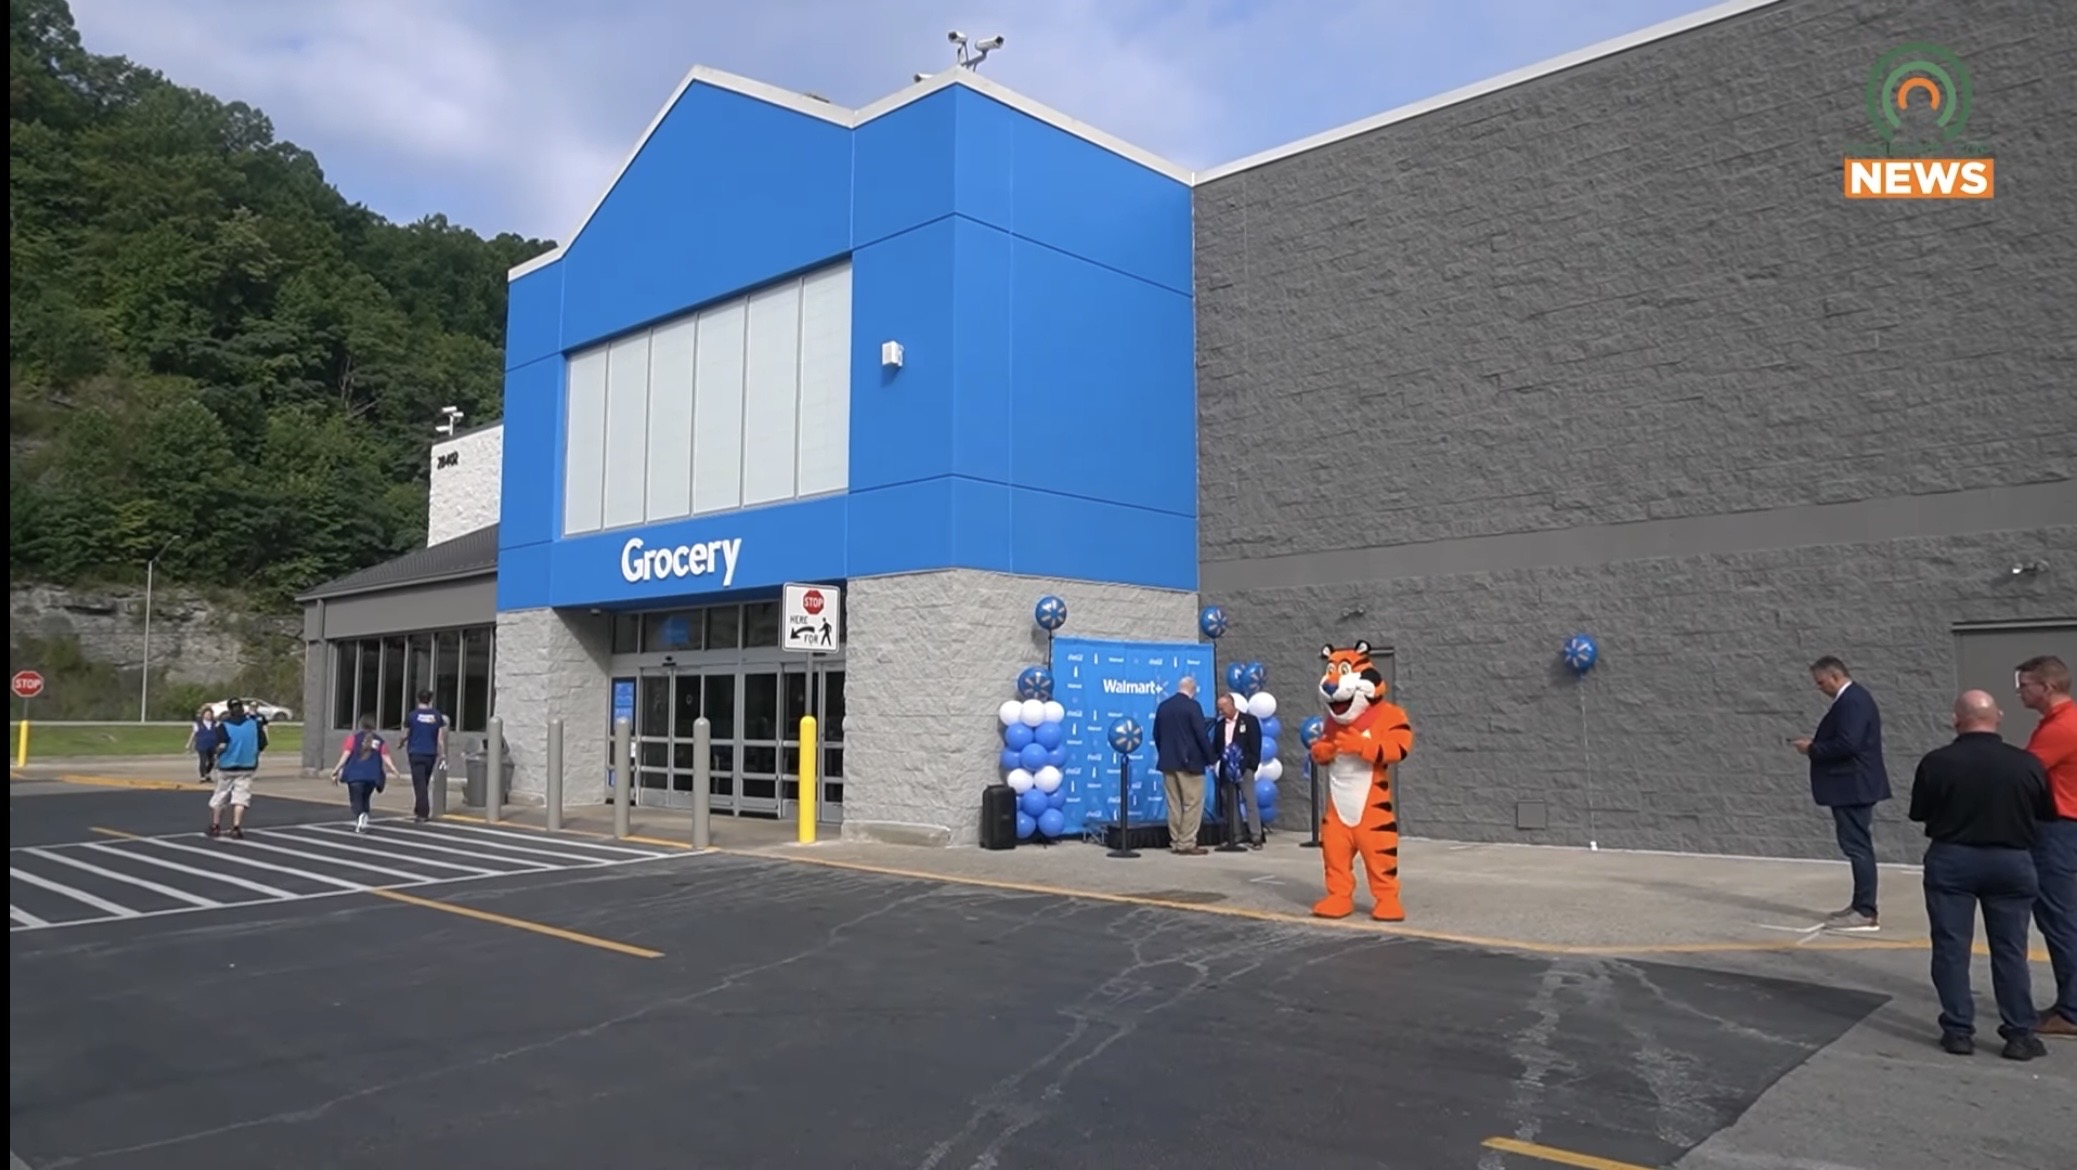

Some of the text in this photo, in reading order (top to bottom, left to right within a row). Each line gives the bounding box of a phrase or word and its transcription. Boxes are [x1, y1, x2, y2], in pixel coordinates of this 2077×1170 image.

[621, 537, 742, 586] Grocery
[804, 597, 824, 608] STOP
[790, 615, 808, 625] HERE
[804, 634, 818, 644] FOR
[15, 678, 41, 689] STOP
